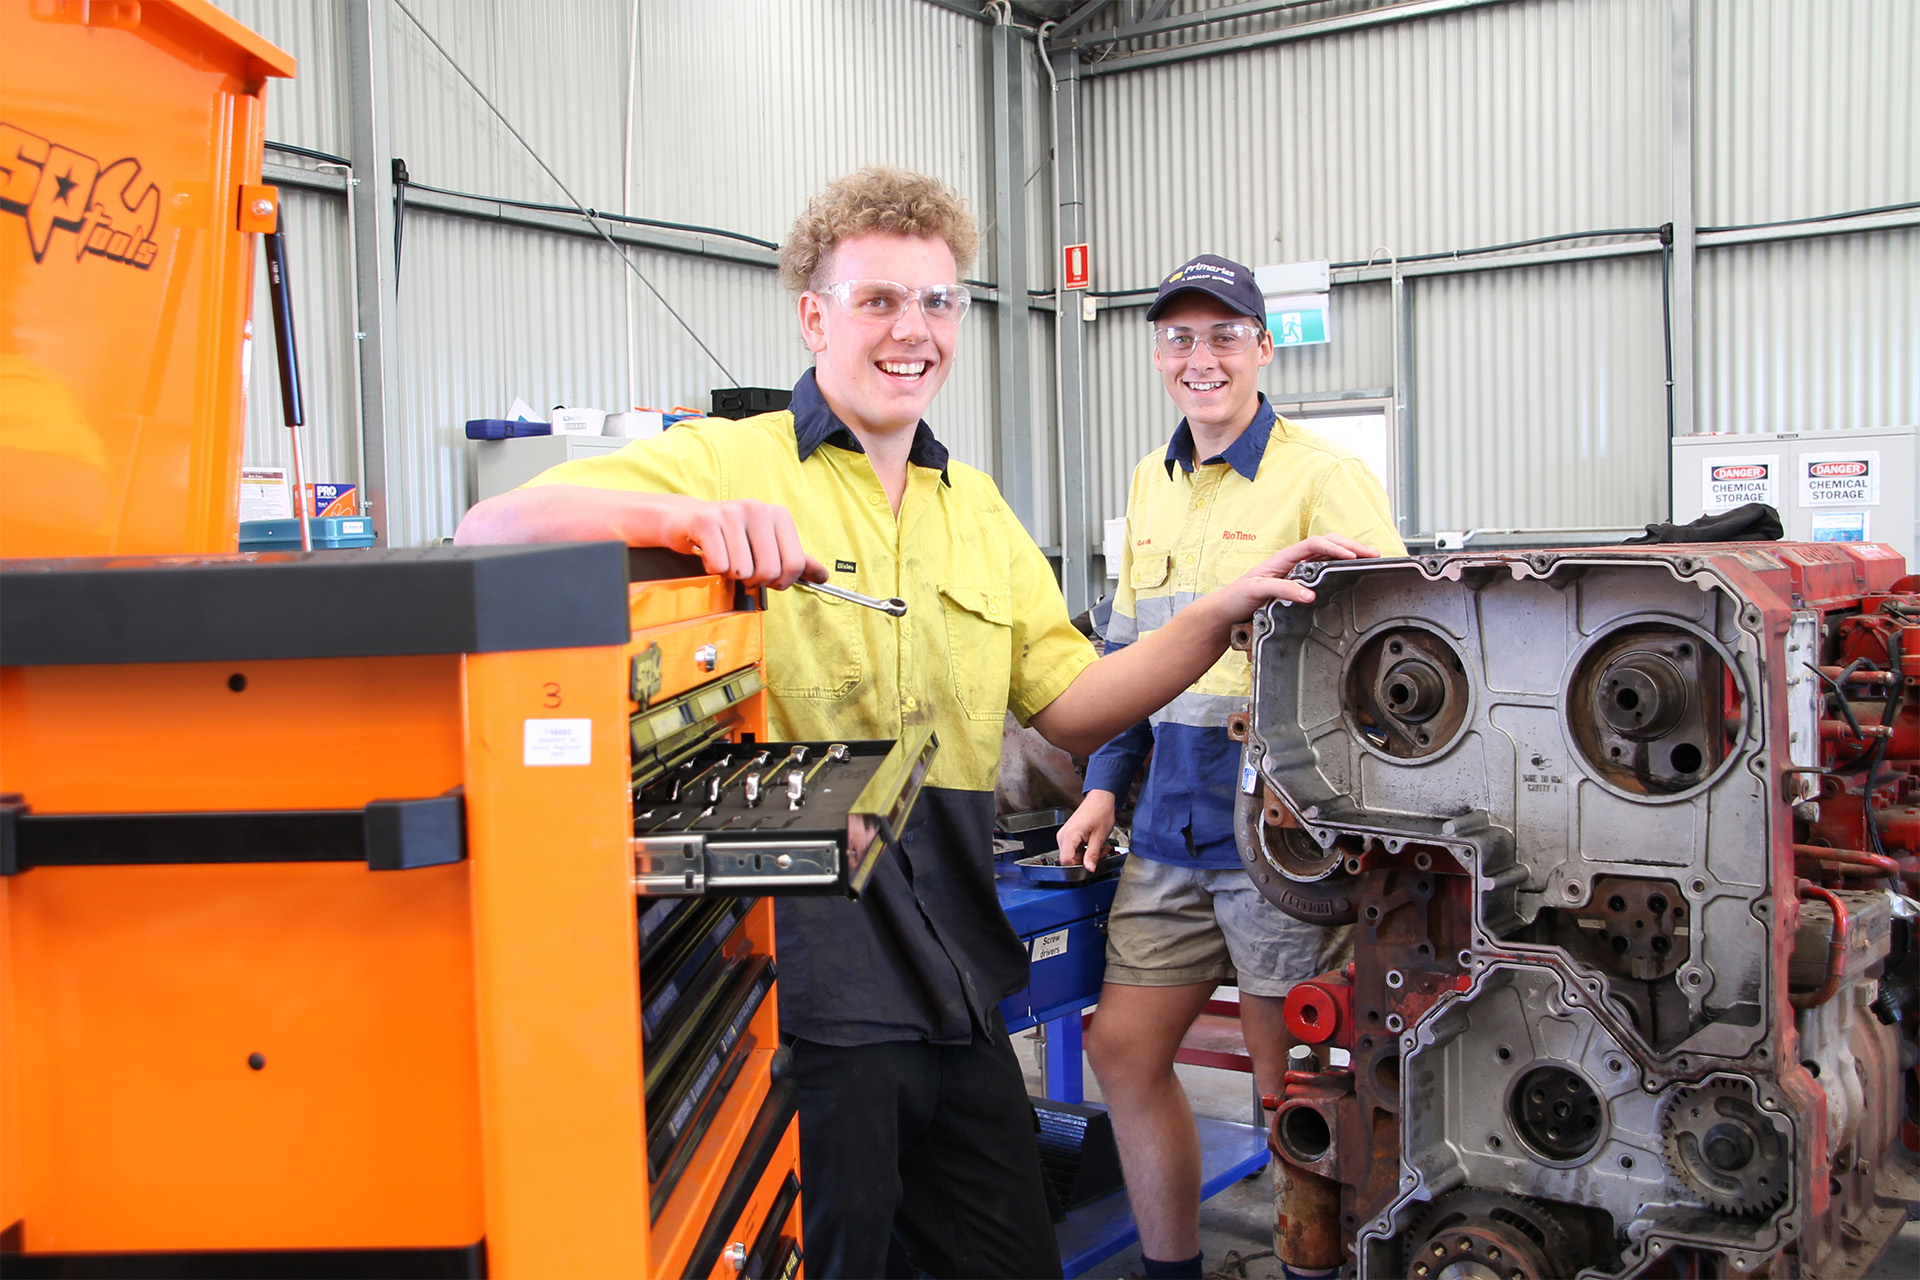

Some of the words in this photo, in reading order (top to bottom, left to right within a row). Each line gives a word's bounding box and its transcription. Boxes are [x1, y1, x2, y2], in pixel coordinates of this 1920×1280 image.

[1184, 262, 1235, 277] Primaries
[1719, 468, 1761, 478] DANGER
[1815, 464, 1861, 475] DANGER
[1712, 482, 1768, 493] CHEMICAL
[1809, 479, 1868, 490] CHEMICAL
[317, 485, 337, 497] PRO
[1812, 490, 1865, 500] STORAGE
[1715, 492, 1765, 503] STORAGE
[543, 682, 563, 709] 3
[1042, 935, 1060, 945] Screw
[1040, 946, 1060, 958] drivers
